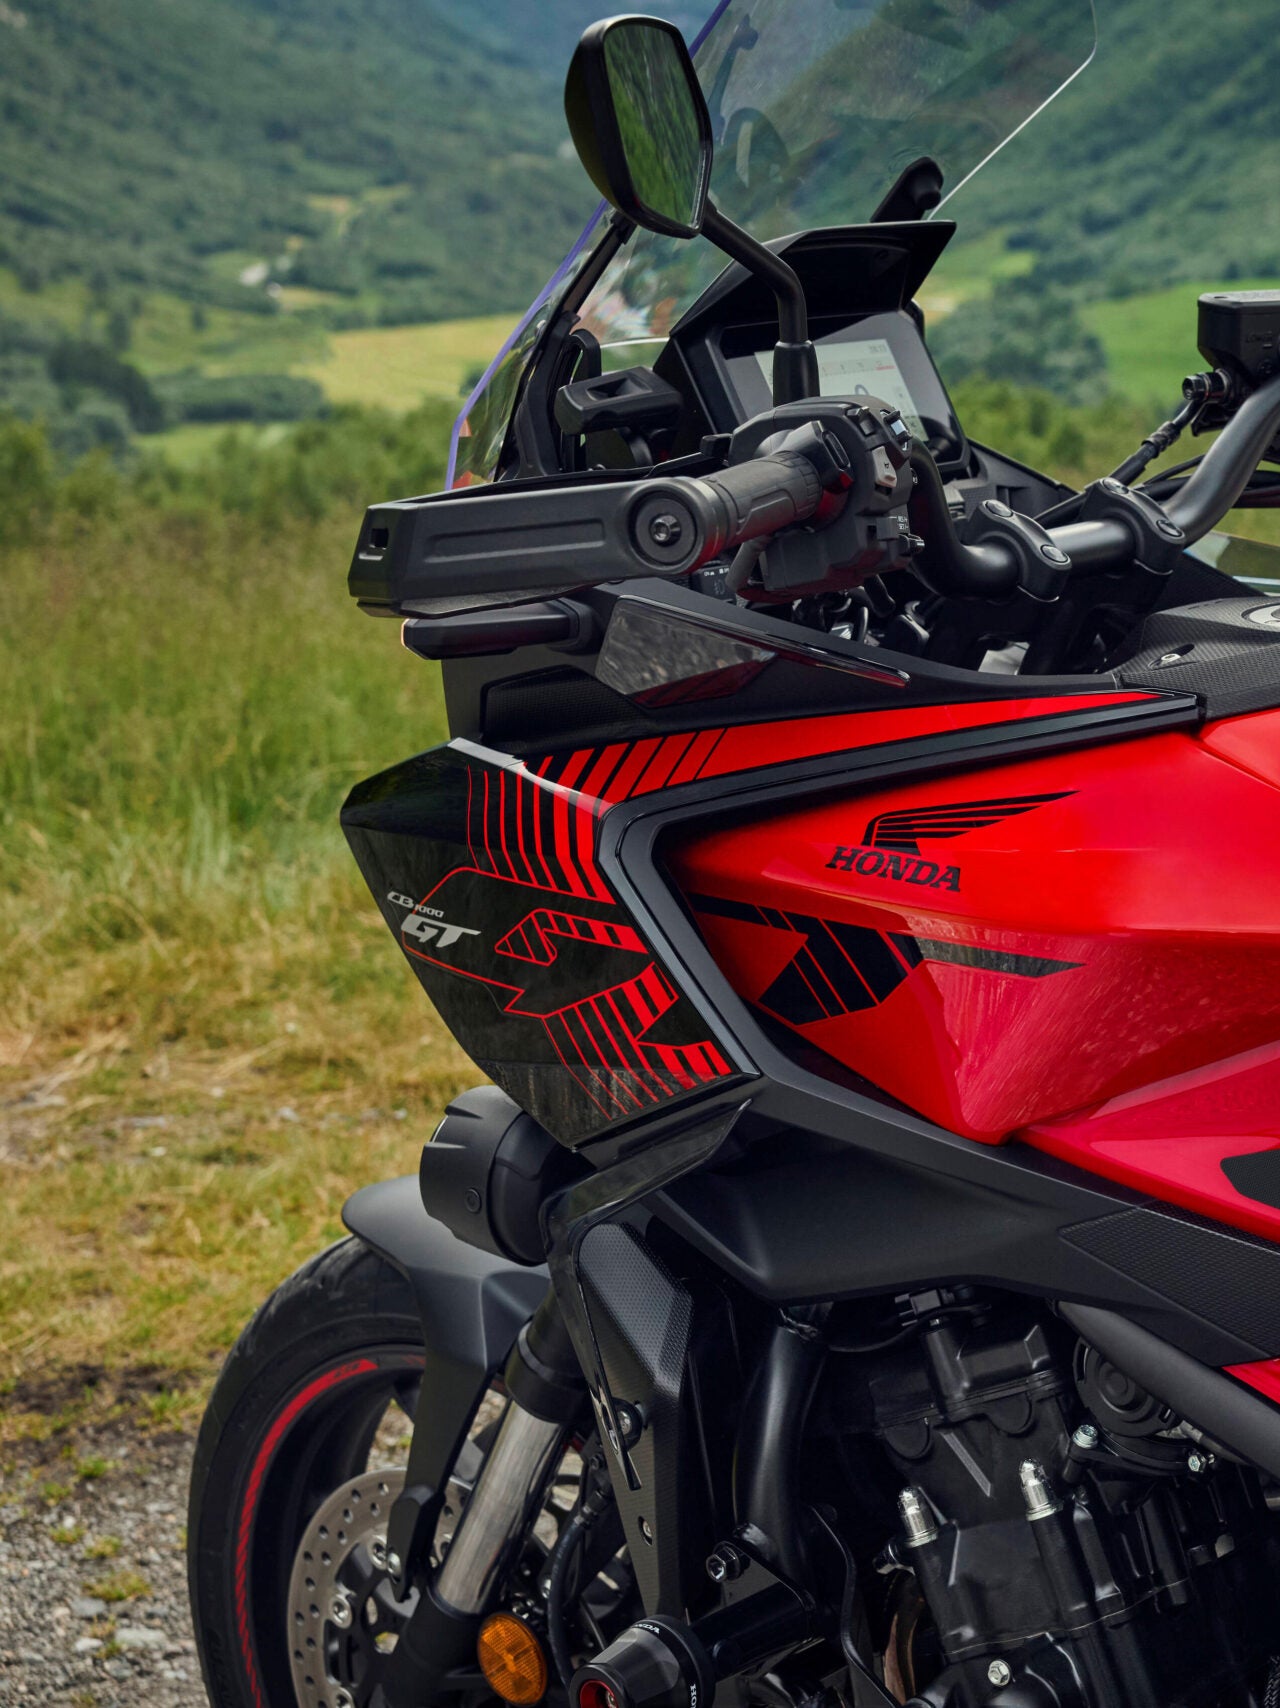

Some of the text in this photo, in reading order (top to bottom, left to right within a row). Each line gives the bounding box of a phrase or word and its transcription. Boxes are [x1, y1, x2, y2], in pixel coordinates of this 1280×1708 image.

[825, 845, 961, 892] HONDA
[400, 913, 482, 948] GT
[690, 1683, 698, 1708] HO
